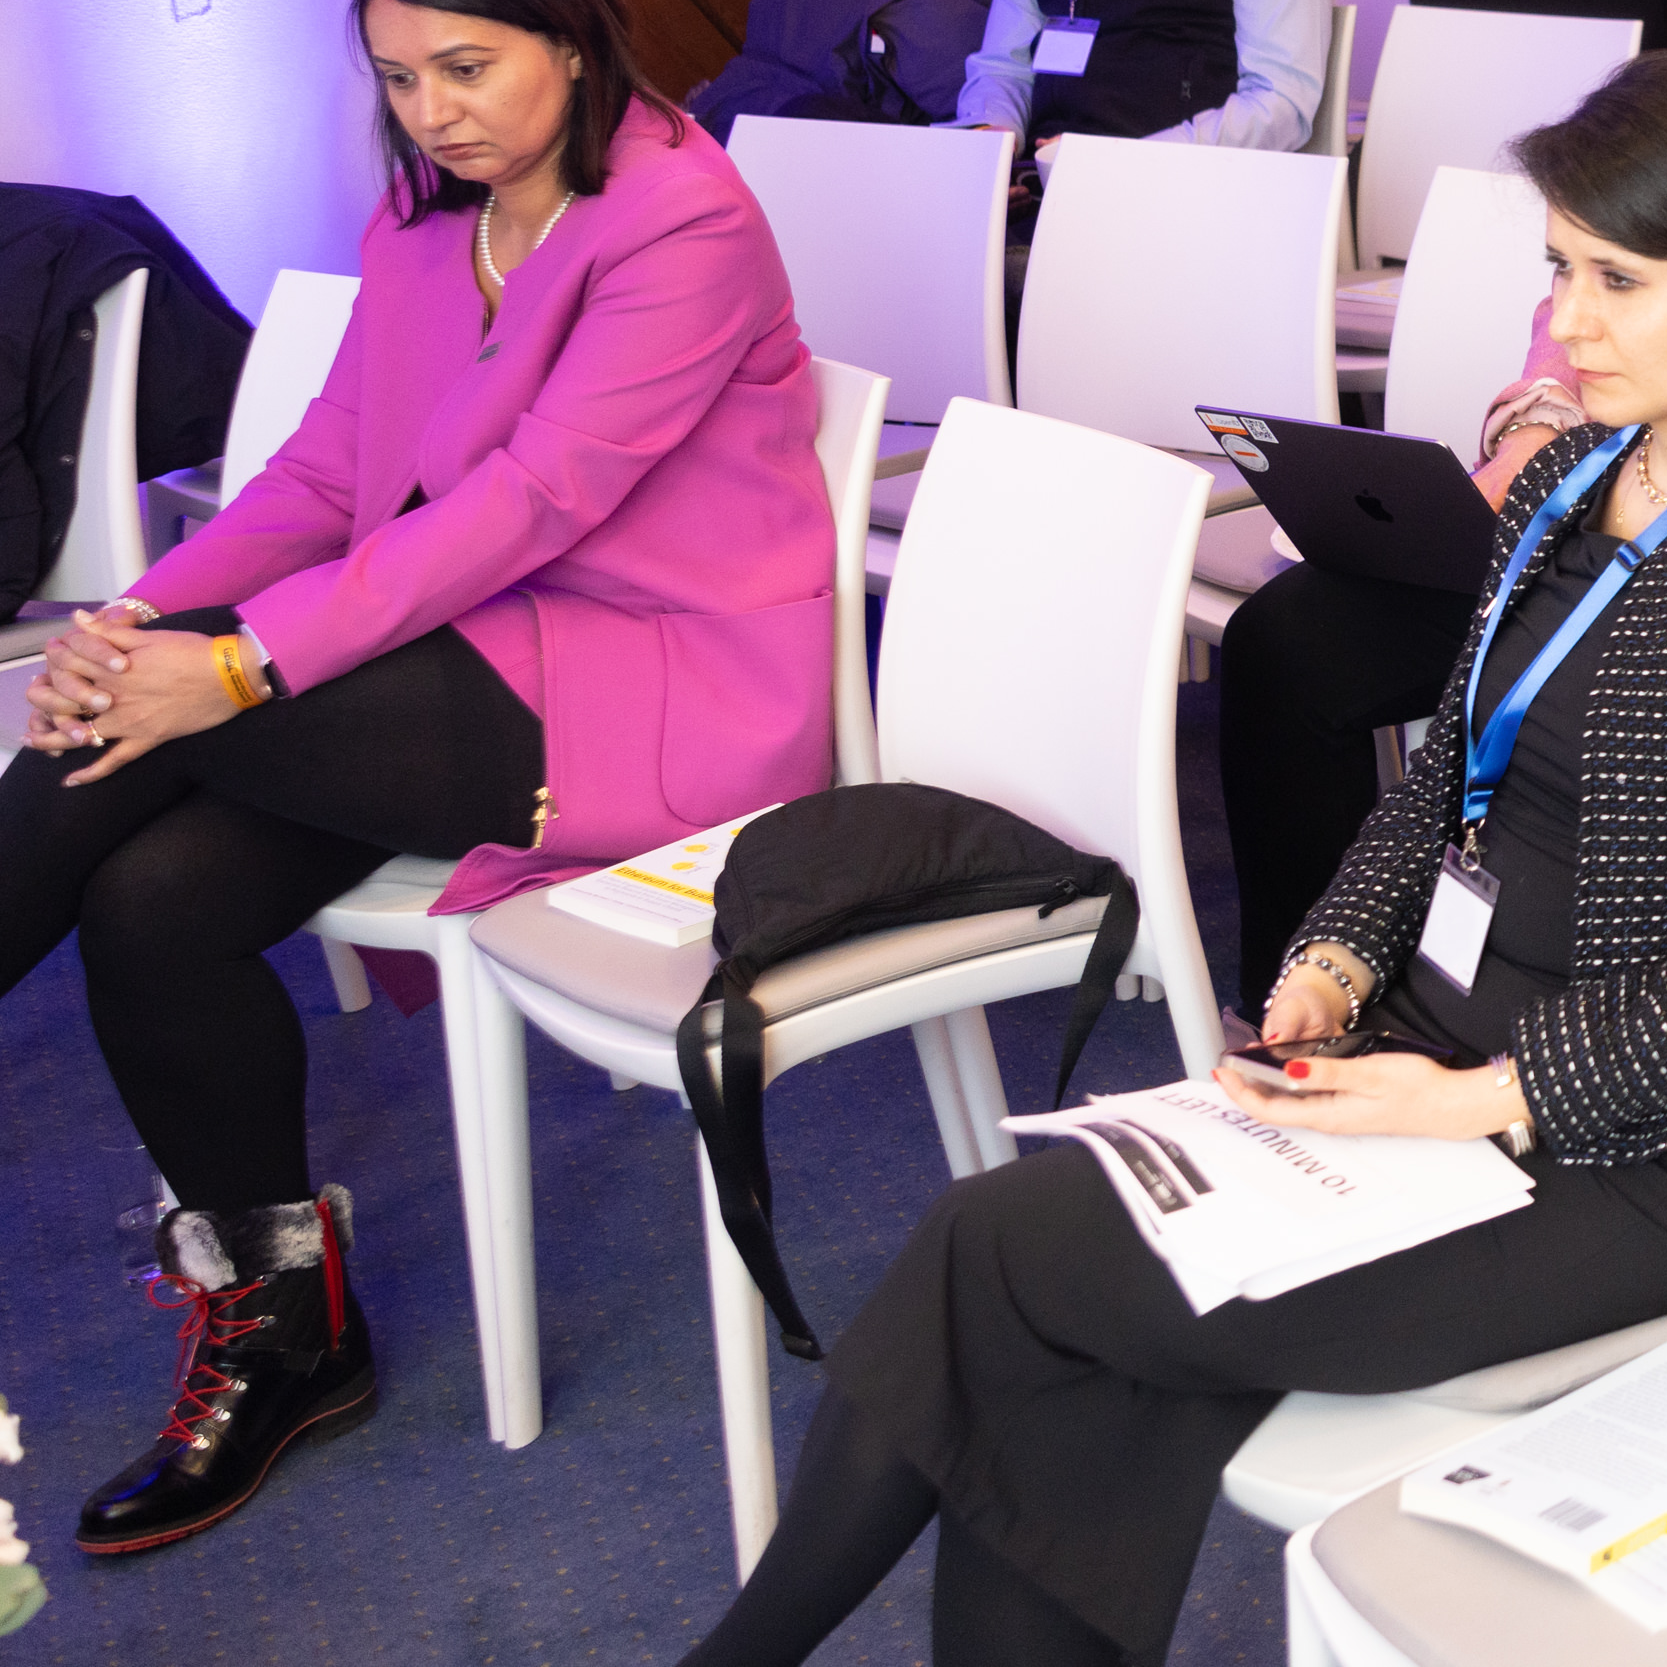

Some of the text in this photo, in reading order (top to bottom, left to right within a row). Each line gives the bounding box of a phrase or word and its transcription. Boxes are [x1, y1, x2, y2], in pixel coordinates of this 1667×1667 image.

[616, 867, 667, 888] Ethereum
[668, 882, 686, 893] for
[1154, 1093, 1357, 1195] 10 MINUTES LEFT
